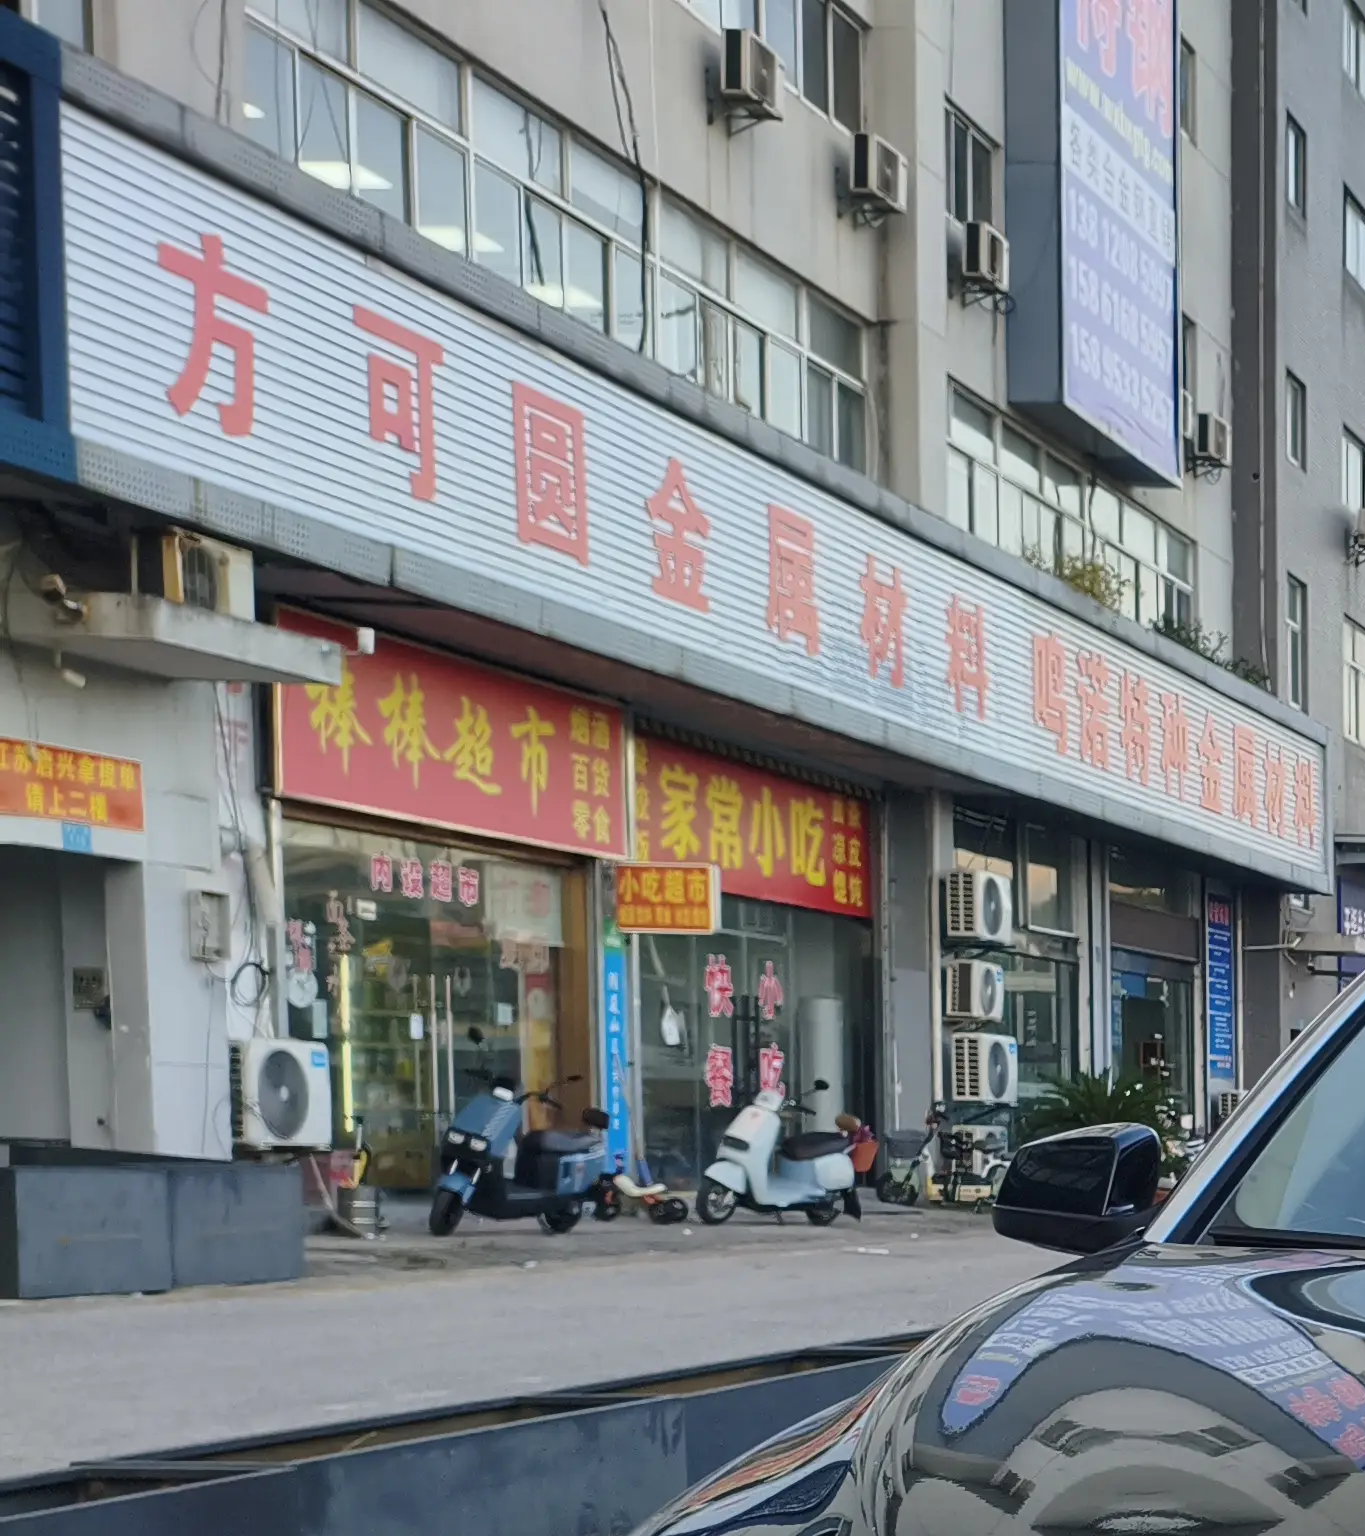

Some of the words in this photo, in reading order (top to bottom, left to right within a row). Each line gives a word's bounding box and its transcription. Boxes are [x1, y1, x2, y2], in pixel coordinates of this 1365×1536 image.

[156, 234, 989, 720] 方可圆金属材料
[1032, 631, 1316, 850] 鸣诺特种金属材料
[305, 660, 555, 817] 棒棒超市
[660, 762, 827, 887] 家常小吃
[758, 960, 786, 1098] 小吃
